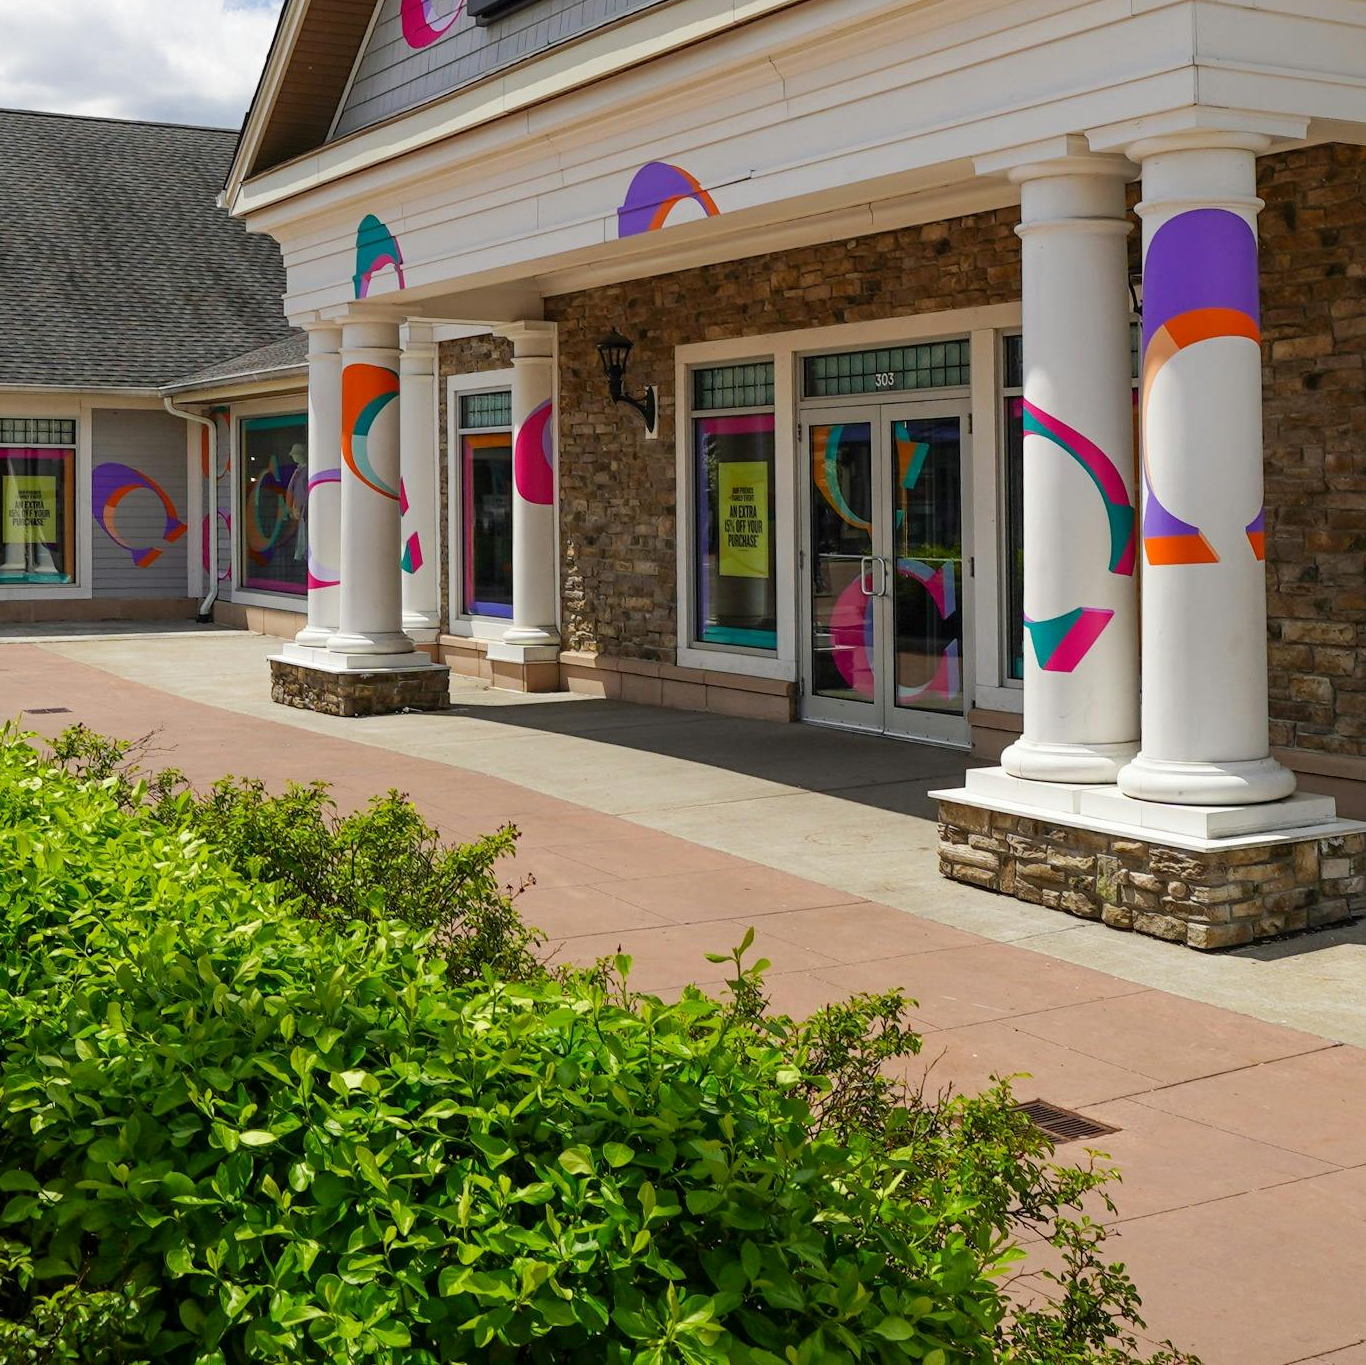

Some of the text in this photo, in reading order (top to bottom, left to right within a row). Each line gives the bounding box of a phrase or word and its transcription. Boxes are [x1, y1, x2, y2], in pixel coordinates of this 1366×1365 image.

[875, 372, 895, 387] 303
[730, 505, 757, 518] AN EXTRA
[736, 519, 746, 533] OFF
[747, 519, 763, 534] YOUR
